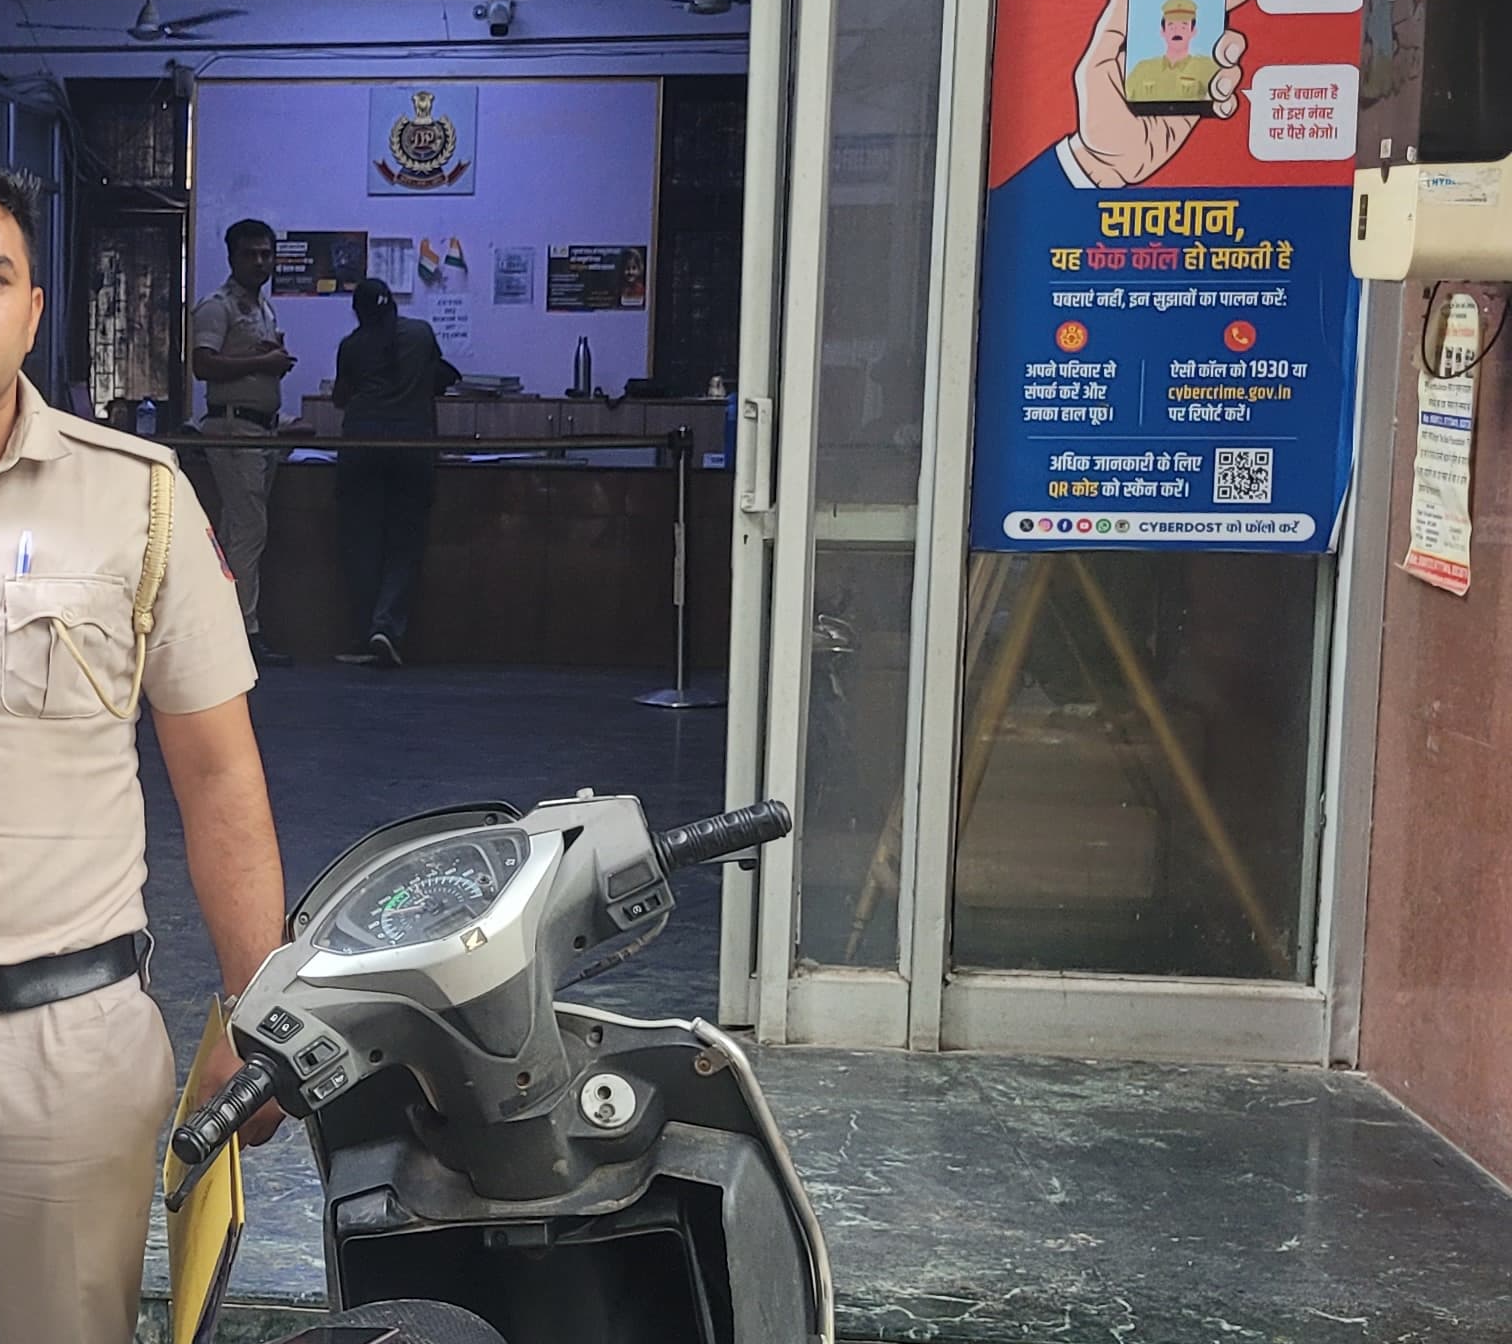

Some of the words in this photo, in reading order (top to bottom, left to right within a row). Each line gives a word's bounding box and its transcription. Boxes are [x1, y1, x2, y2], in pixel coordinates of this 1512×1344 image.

[1294, 87, 1328, 101] बचाना
[1330, 83, 1340, 100] है
[1272, 105, 1285, 121] तो
[1286, 107, 1305, 121] इस
[1307, 106, 1334, 120] नंबर
[1269, 126, 1284, 141] पर
[1287, 124, 1306, 141] पैसे
[1098, 200, 1245, 242] सावधान,
[1049, 247, 1083, 270] यह
[1086, 242, 1127, 270] फेक
[1130, 242, 1179, 270] कॉल
[1182, 241, 1207, 270] हो
[1209, 240, 1274, 270] सकती
[1276, 239, 1294, 270] है
[1052, 288, 1094, 308] घबराएं
[1128, 291, 1150, 308] इन
[1152, 288, 1197, 312] सुझावों
[1199, 291, 1217, 307] का
[1219, 291, 1259, 307] पालन
[1025, 359, 1057, 379] अपने
[1058, 359, 1101, 378] परिवार
[1103, 359, 1117, 378] से
[1170, 359, 1196, 379] ऐसी
[1198, 359, 1227, 378] कॉल
[1229, 359, 1247, 378] को
[1248, 359, 1289, 378] 1930
[1292, 362, 1308, 378] या
[1024, 384, 1057, 400] संपर्क
[1058, 383, 1081, 400] करें
[1167, 384, 1292, 402] cybercrime.gov.in
[1023, 406, 1058, 422] उनका
[1060, 406, 1086, 422] हाल
[1168, 407, 1187, 422] पर
[1188, 404, 1223, 422] रिपोर्ट
[1048, 452, 1092, 472] अधिक
[1093, 452, 1155, 472] जानकारी
[1156, 452, 1171, 472] के
[1173, 452, 1203, 472] लिए
[1048, 481, 1068, 498] QR
[1071, 479, 1099, 498] कोड
[1101, 478, 1121, 497] को
[1122, 478, 1158, 498] स्कैन
[1138, 521, 1223, 534] CYBERDOST
[1225, 520, 1241, 534] को
[1244, 519, 1276, 534] फॉलो
[1278, 520, 1301, 534] करें
